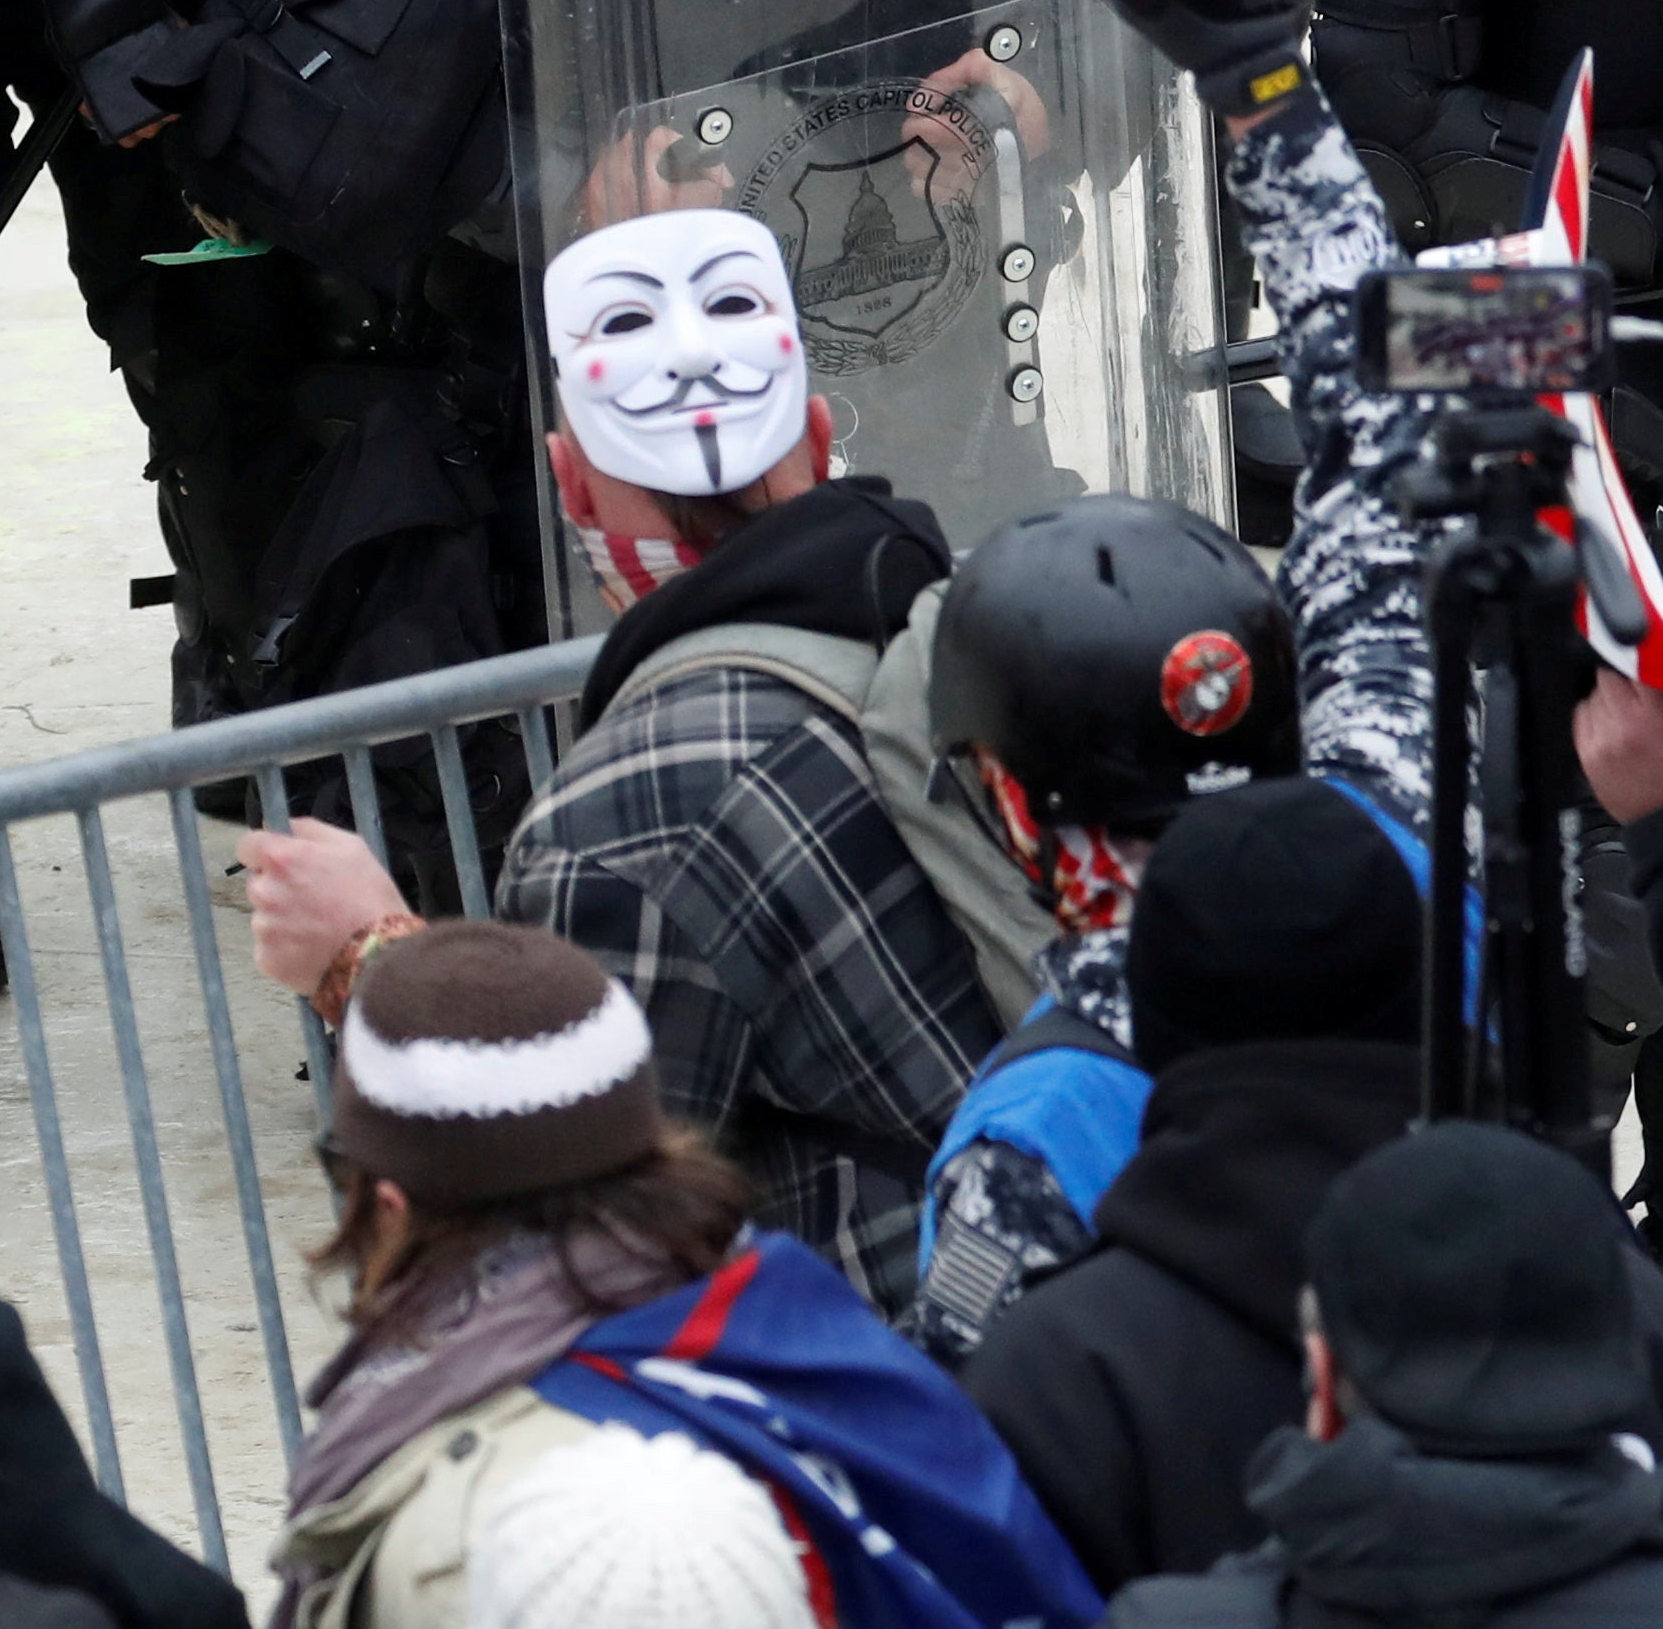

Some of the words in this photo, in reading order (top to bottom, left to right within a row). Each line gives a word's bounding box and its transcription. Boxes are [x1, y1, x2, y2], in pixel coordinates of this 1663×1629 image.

[784, 101, 851, 151] STATES
[855, 90, 934, 113] CAPITOL
[938, 100, 992, 157] POLICE
